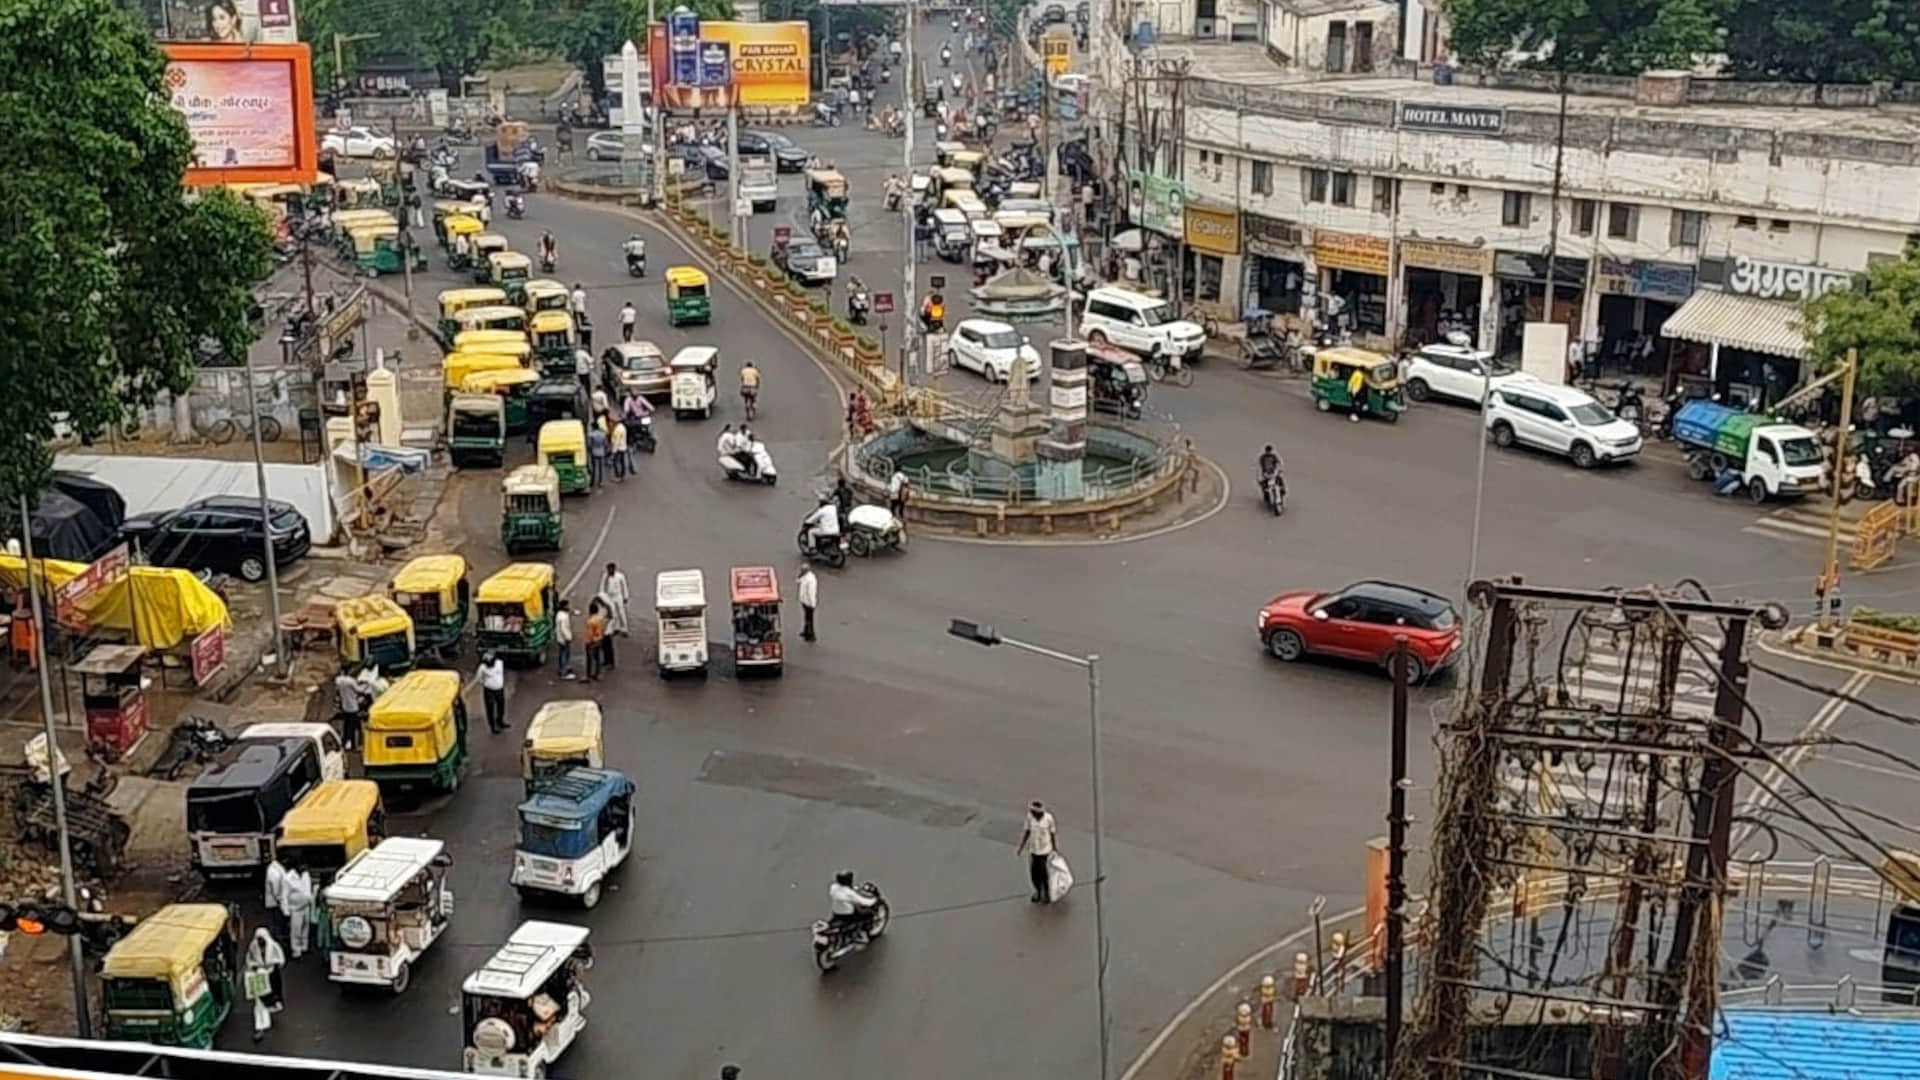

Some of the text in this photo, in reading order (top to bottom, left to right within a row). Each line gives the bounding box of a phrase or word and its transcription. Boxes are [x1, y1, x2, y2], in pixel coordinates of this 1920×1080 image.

[732, 58, 805, 72] CRYSTAL
[1404, 108, 1500, 127] HOTEL MAYUR
